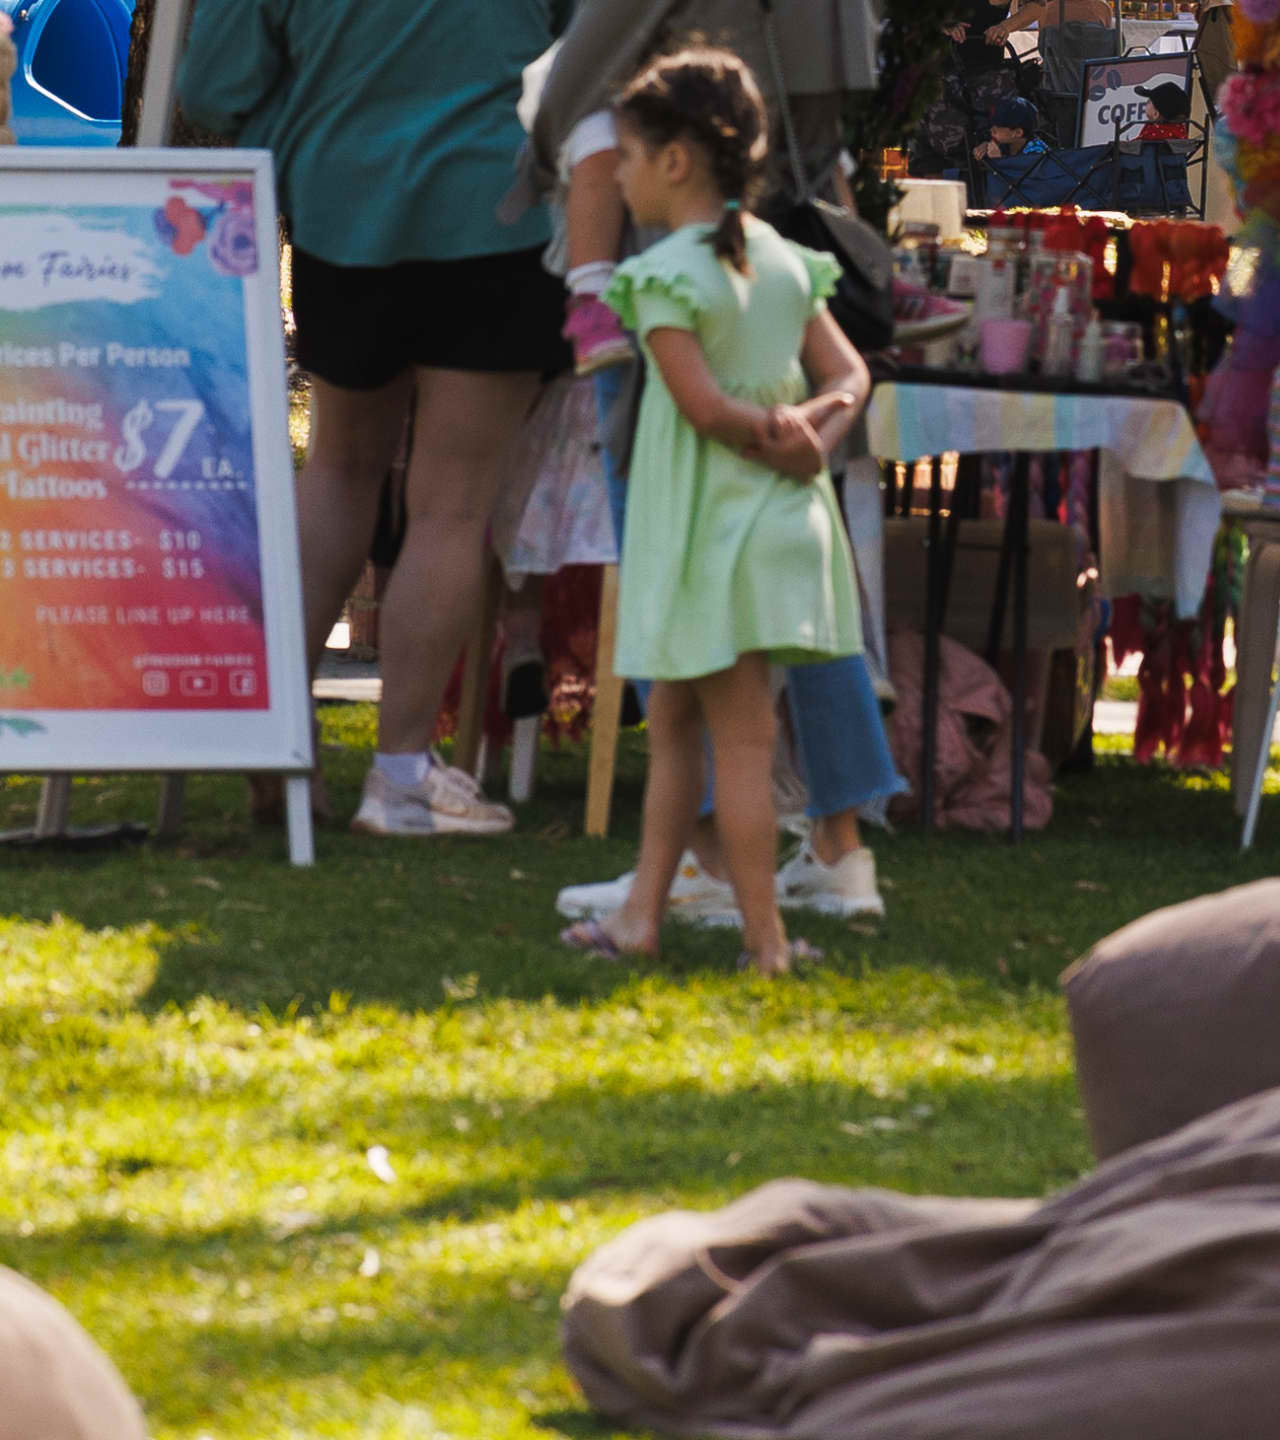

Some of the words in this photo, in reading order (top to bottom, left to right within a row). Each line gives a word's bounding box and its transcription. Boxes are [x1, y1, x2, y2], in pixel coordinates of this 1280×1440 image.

[1098, 102, 1147, 125] COFF
[0, 341, 54, 367] ices
[58, 341, 100, 367] Per
[106, 341, 191, 367] Person
[0, 397, 104, 430] ainting
[17, 432, 110, 467] Glitter
[112, 398, 204, 478] $7
[4, 470, 107, 499] Tattoos
[159, 530, 201, 552] $10
[36, 605, 109, 624] PLEASE
[116, 605, 160, 625] LINE
[166, 606, 194, 624] UP
[199, 605, 249, 625] HERE
